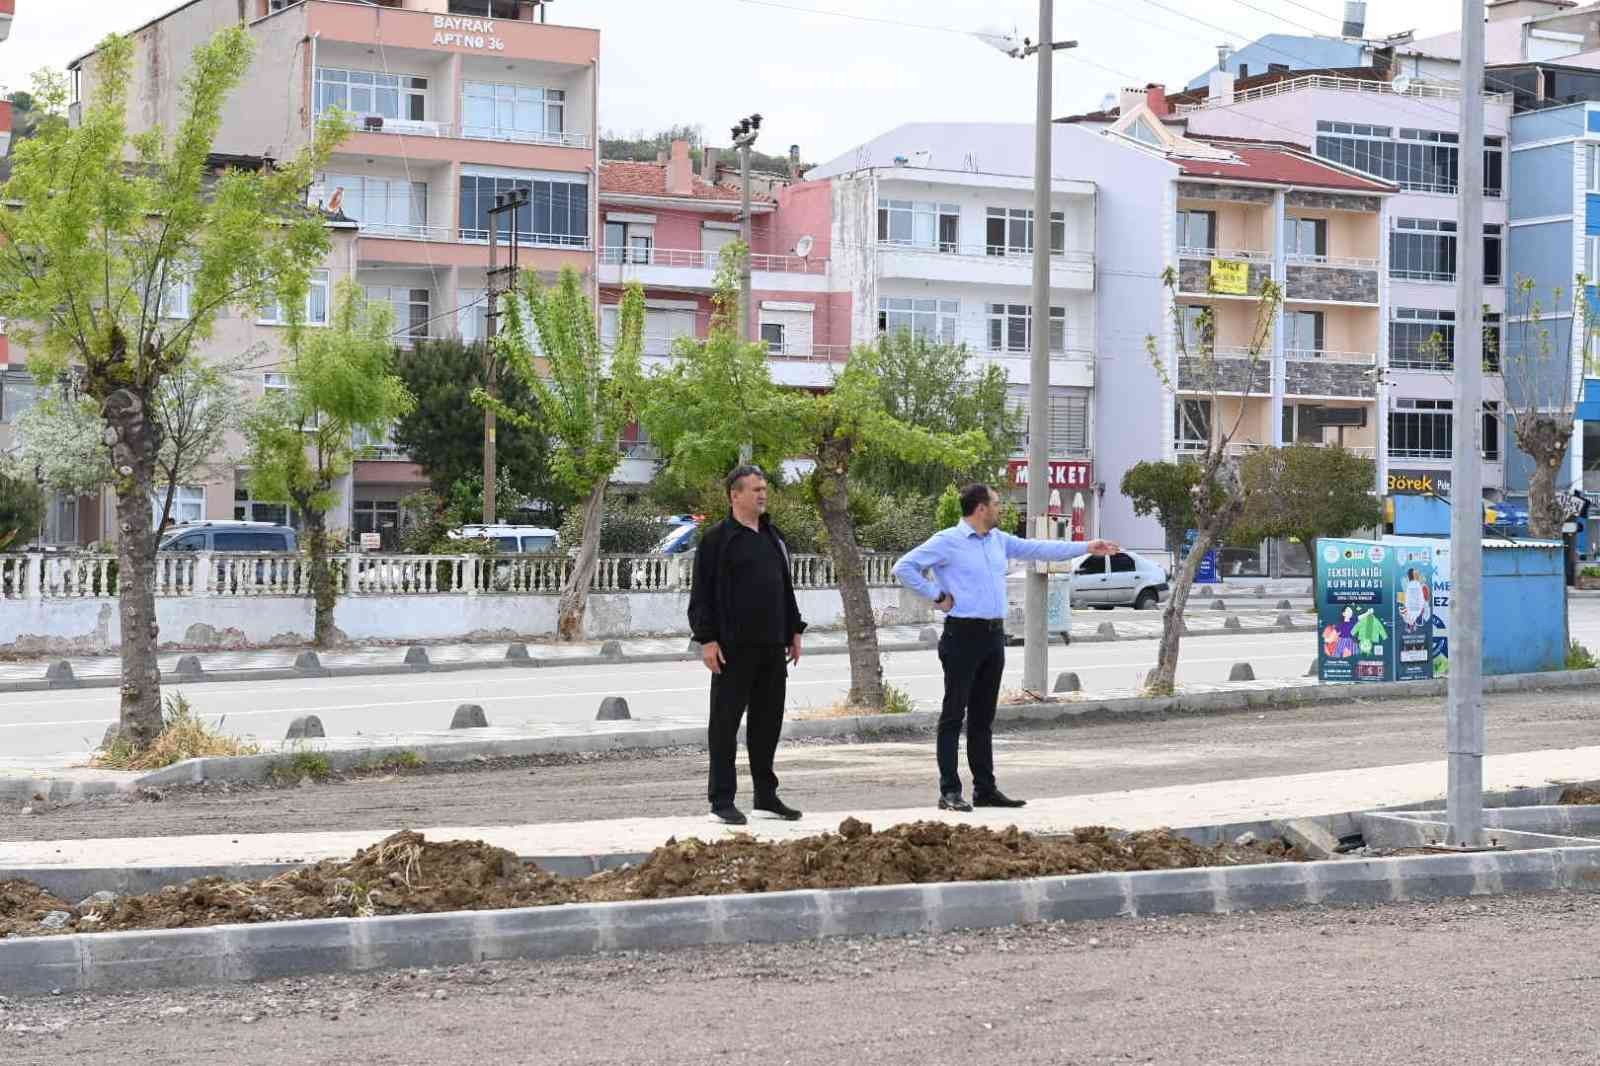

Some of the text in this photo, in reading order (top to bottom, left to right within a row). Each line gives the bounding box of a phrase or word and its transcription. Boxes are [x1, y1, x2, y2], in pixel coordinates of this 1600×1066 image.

[432, 15, 495, 33] BAYRAK
[487, 37, 505, 50] 36
[1015, 465, 1087, 484] MRKET
